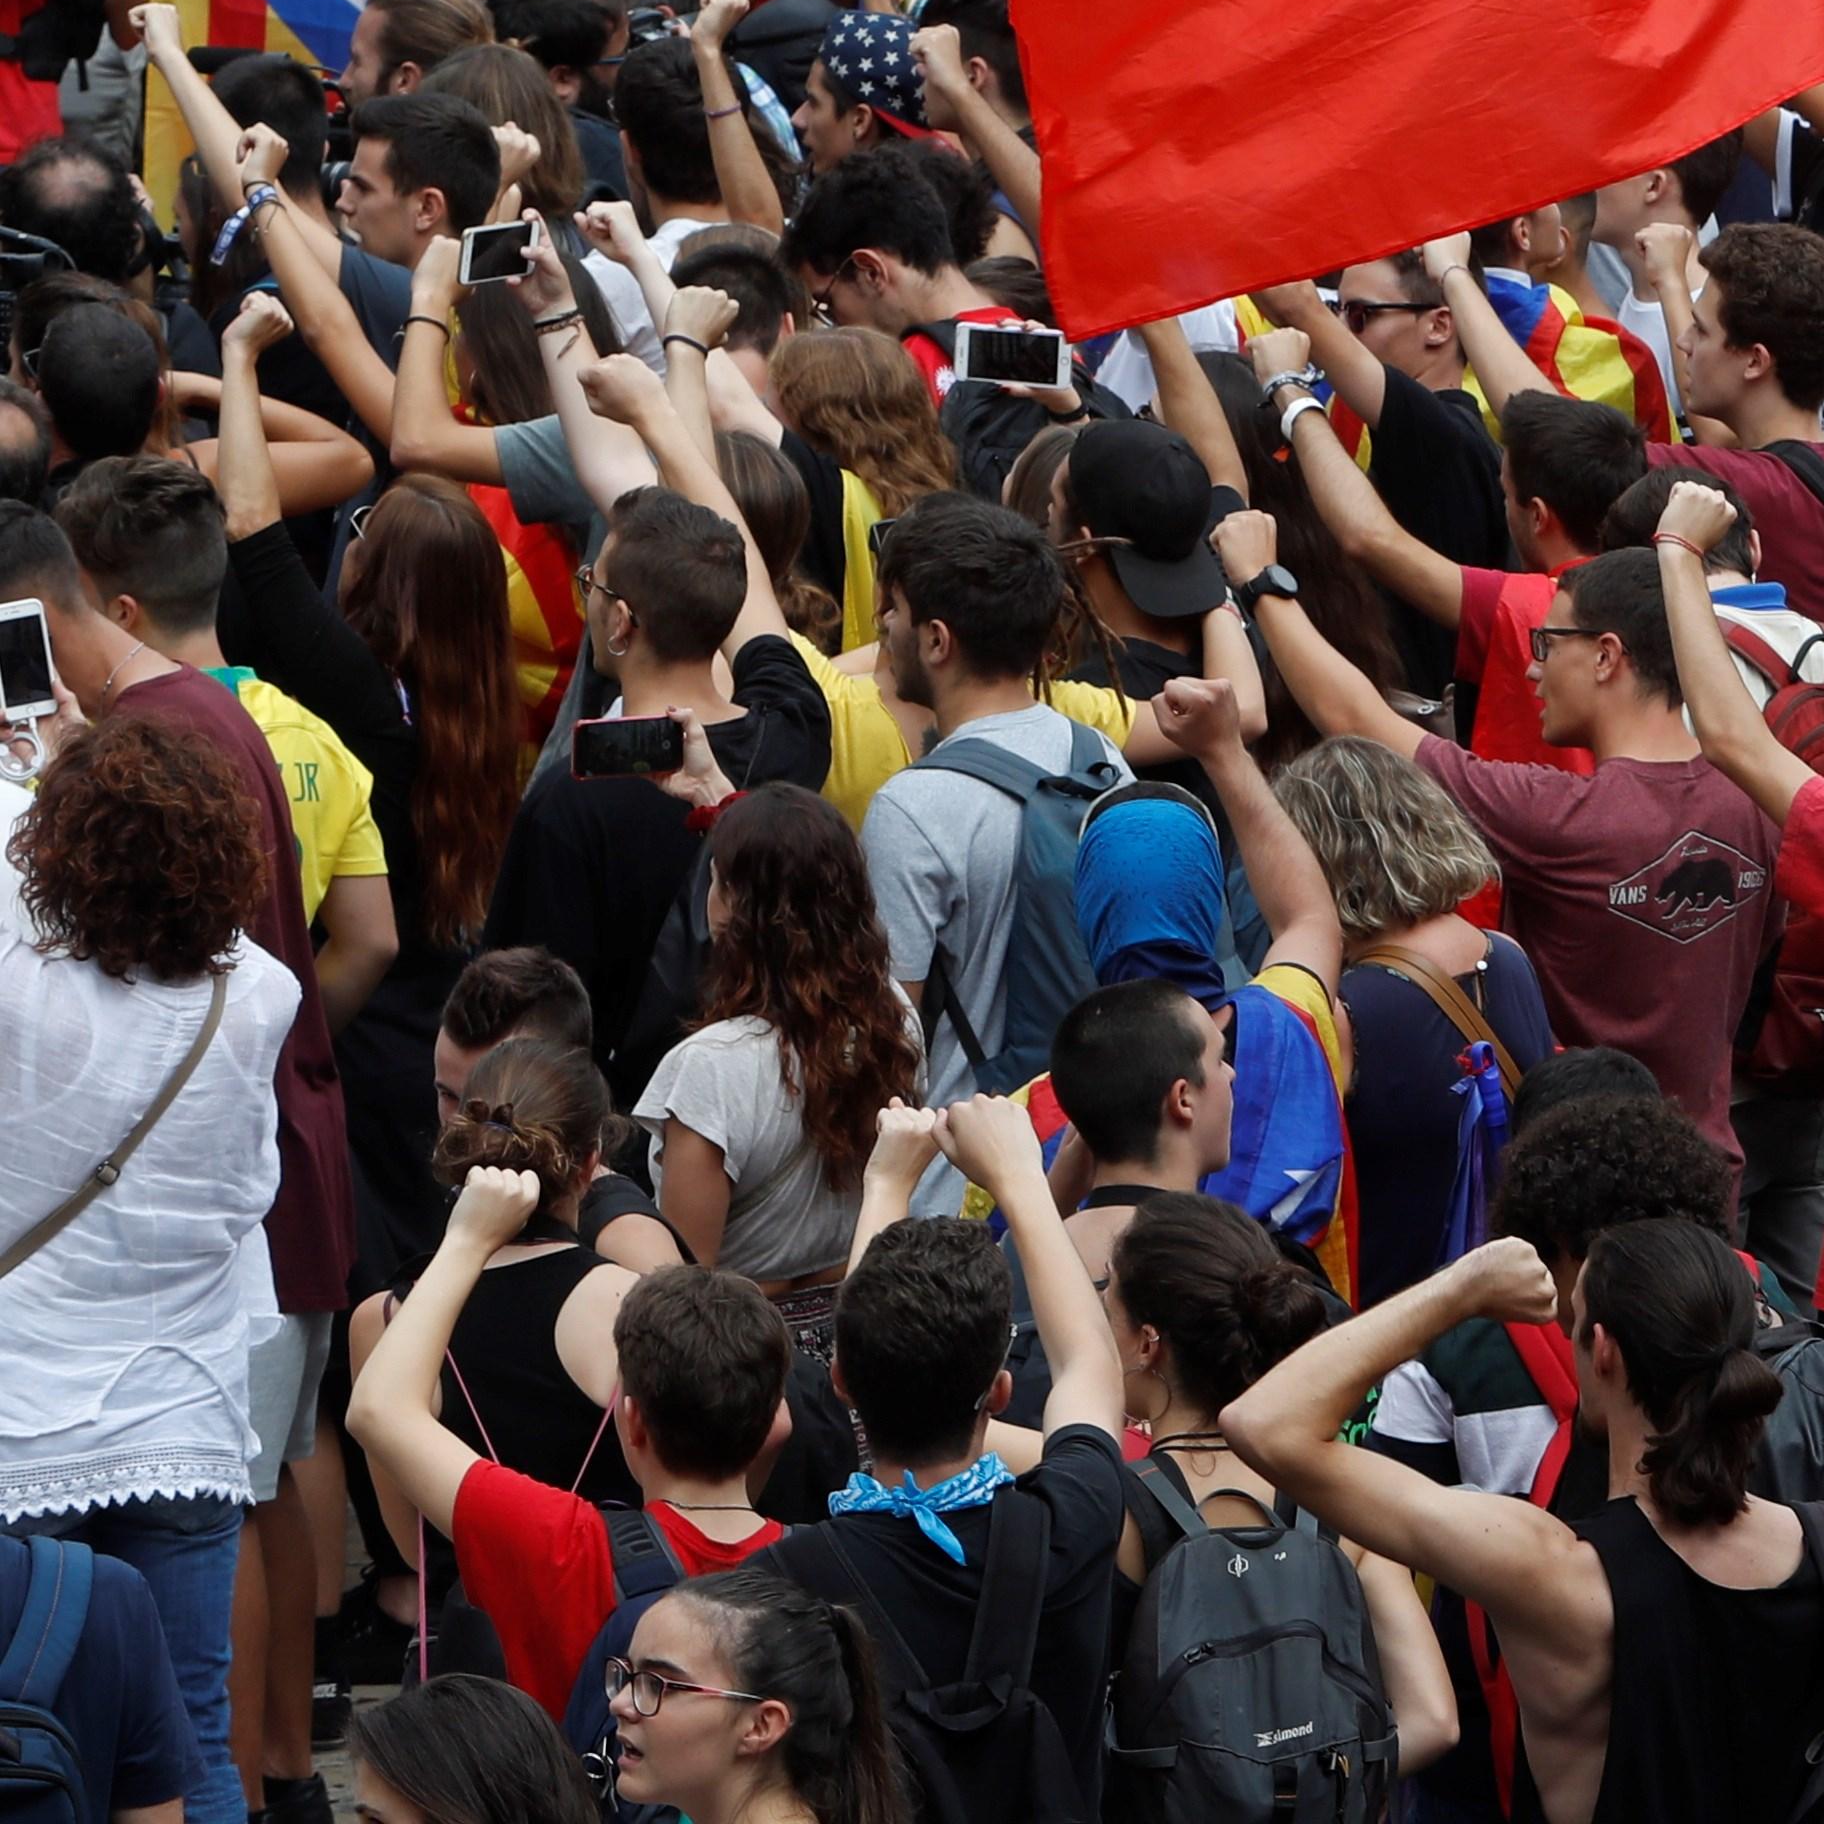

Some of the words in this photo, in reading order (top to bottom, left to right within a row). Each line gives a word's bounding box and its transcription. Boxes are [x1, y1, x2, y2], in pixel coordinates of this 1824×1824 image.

[293, 762, 319, 802] JR
[1609, 885, 1648, 905] VANS
[1271, 1721, 1314, 1747] simond
